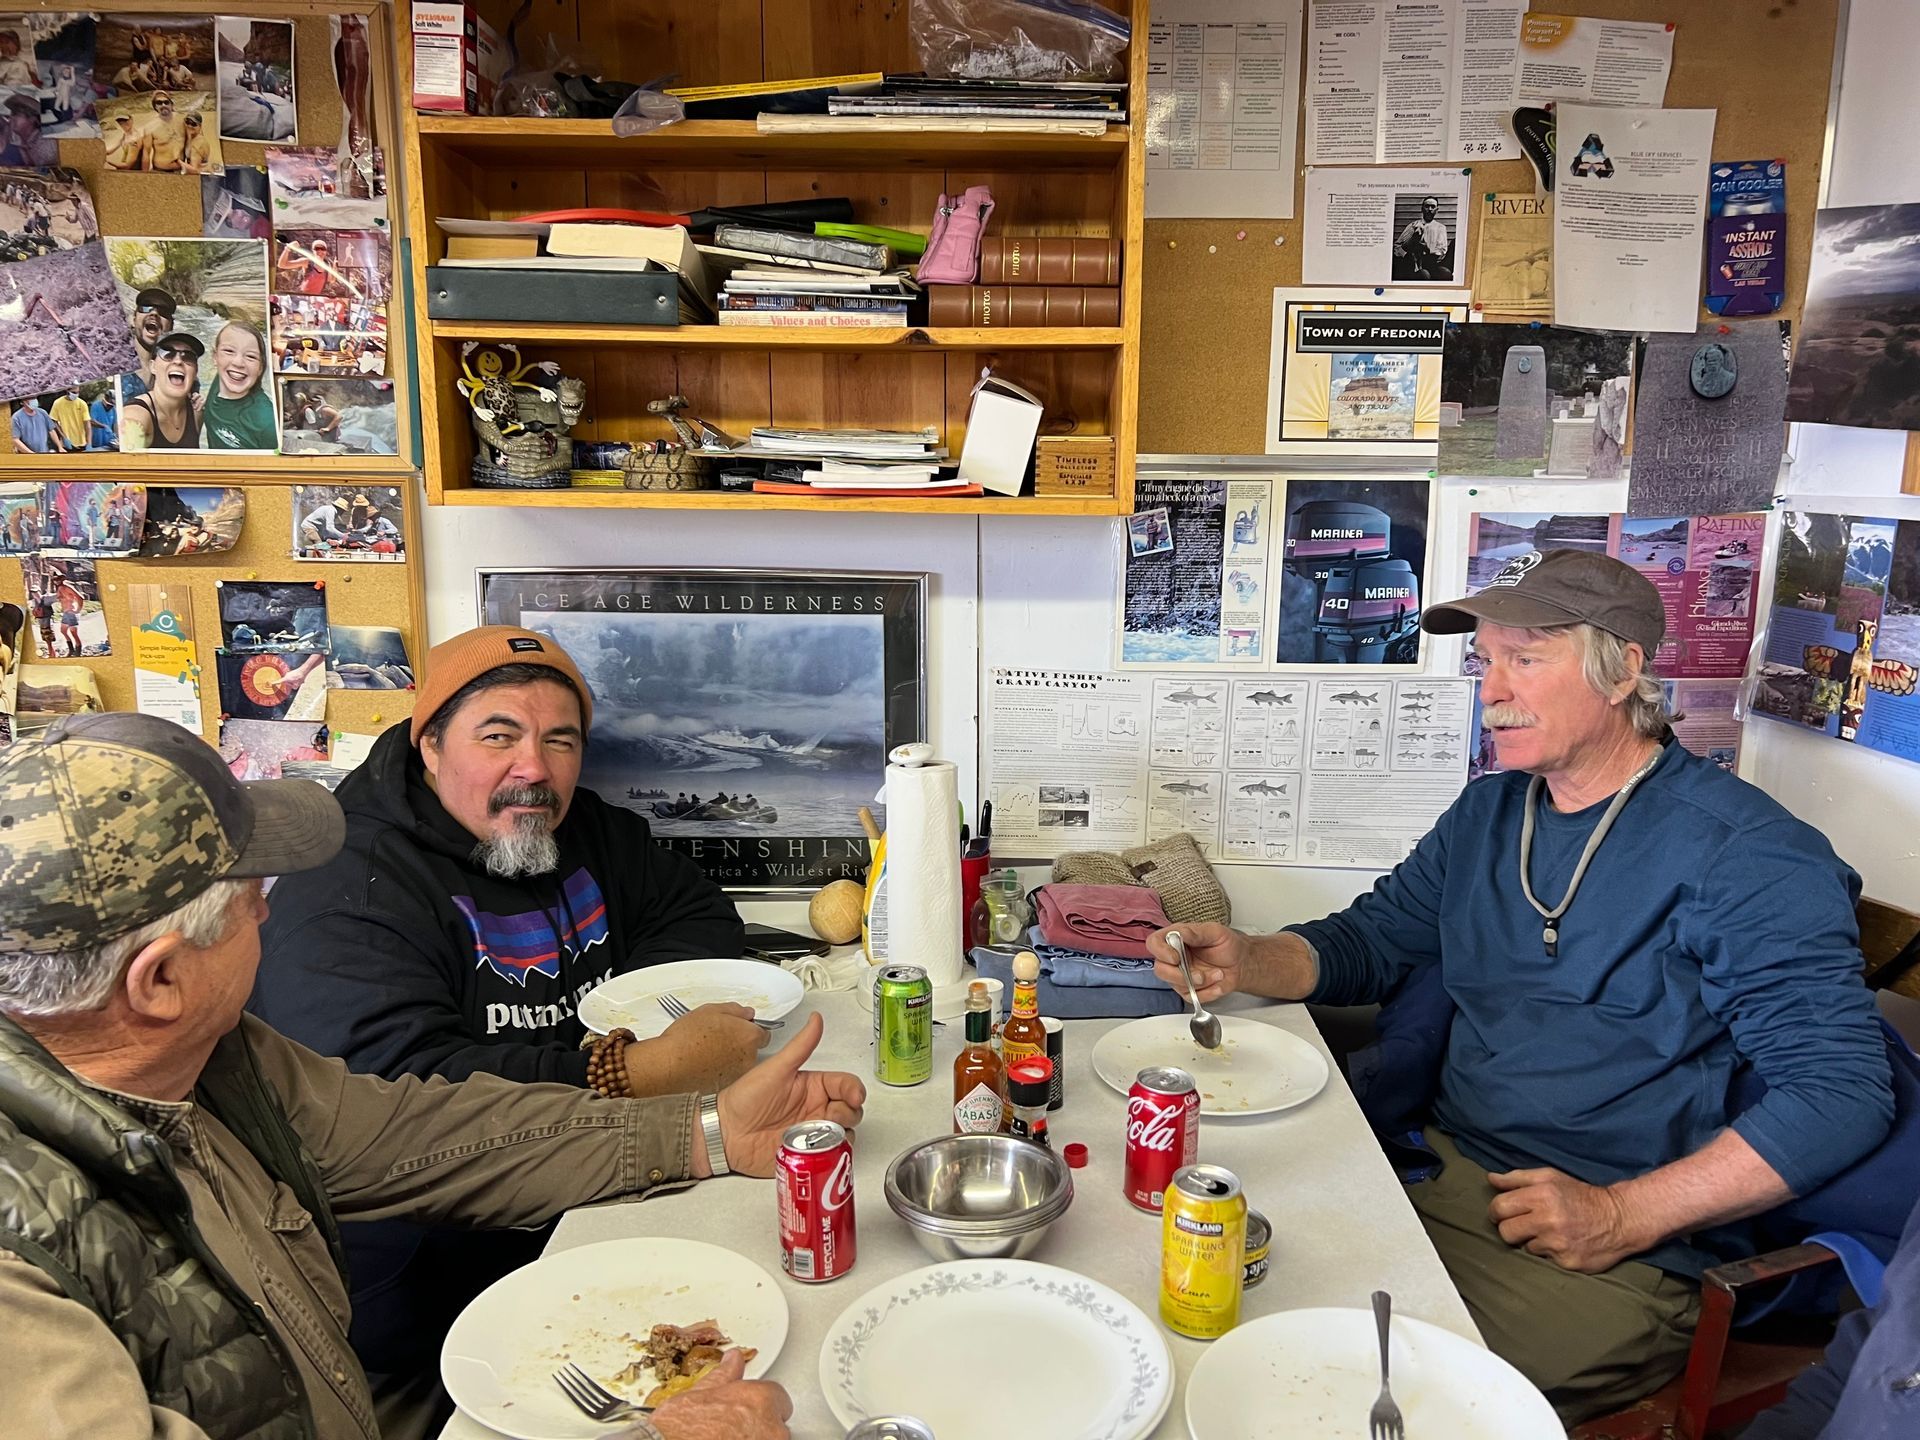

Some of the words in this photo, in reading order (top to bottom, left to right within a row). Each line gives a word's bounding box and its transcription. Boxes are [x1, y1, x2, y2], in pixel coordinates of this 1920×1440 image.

[415, 13, 455, 22] SYLVANIA
[1527, 20, 1561, 28] Protecting
[1539, 142, 1549, 156] no
[1711, 181, 1736, 193] CAN
[1737, 178, 1783, 192] COOLER
[1490, 199, 1545, 215] RIVER
[1725, 230, 1776, 243] INSTANT
[1729, 242, 1773, 258] ASSHOLE
[983, 290, 991, 325] PHOTOS
[769, 315, 804, 326] Values
[807, 316, 827, 326] and
[830, 315, 871, 326] Choices
[1303, 326, 1344, 338] TOWN
[1348, 328, 1367, 338] OF
[1370, 327, 1442, 339] FREDONIA
[1679, 434, 1740, 447] POWELL
[1055, 455, 1098, 465] TIMELESS
[1681, 453, 1736, 465] SOLDIER
[1164, 484, 1191, 495] engine
[1678, 482, 1718, 497] DEAN
[1696, 515, 1762, 534] RAFTING
[1310, 528, 1364, 539] MARINER
[1286, 539, 1296, 547] 30
[1314, 571, 1329, 579] 30
[1365, 587, 1410, 599] MARINER
[1688, 570, 1711, 618] HIKING
[519, 593, 570, 608] ICE
[594, 594, 652, 609] AGE
[676, 595, 884, 611] WILDERNESS
[1325, 598, 1349, 610] 40
[1053, 671, 1103, 682] FISHES
[996, 678, 1041, 687] GRAND
[1045, 680, 1097, 690] CANYON
[702, 863, 758, 877] erica's
[765, 863, 832, 877] Wildest
[841, 863, 866, 877] Riv
[822, 1215, 831, 1233] ME
[1176, 1215, 1223, 1233] KIRKLAND
[1171, 1232, 1226, 1251] SPARKLING
[824, 1234, 833, 1277] RECYCLE
